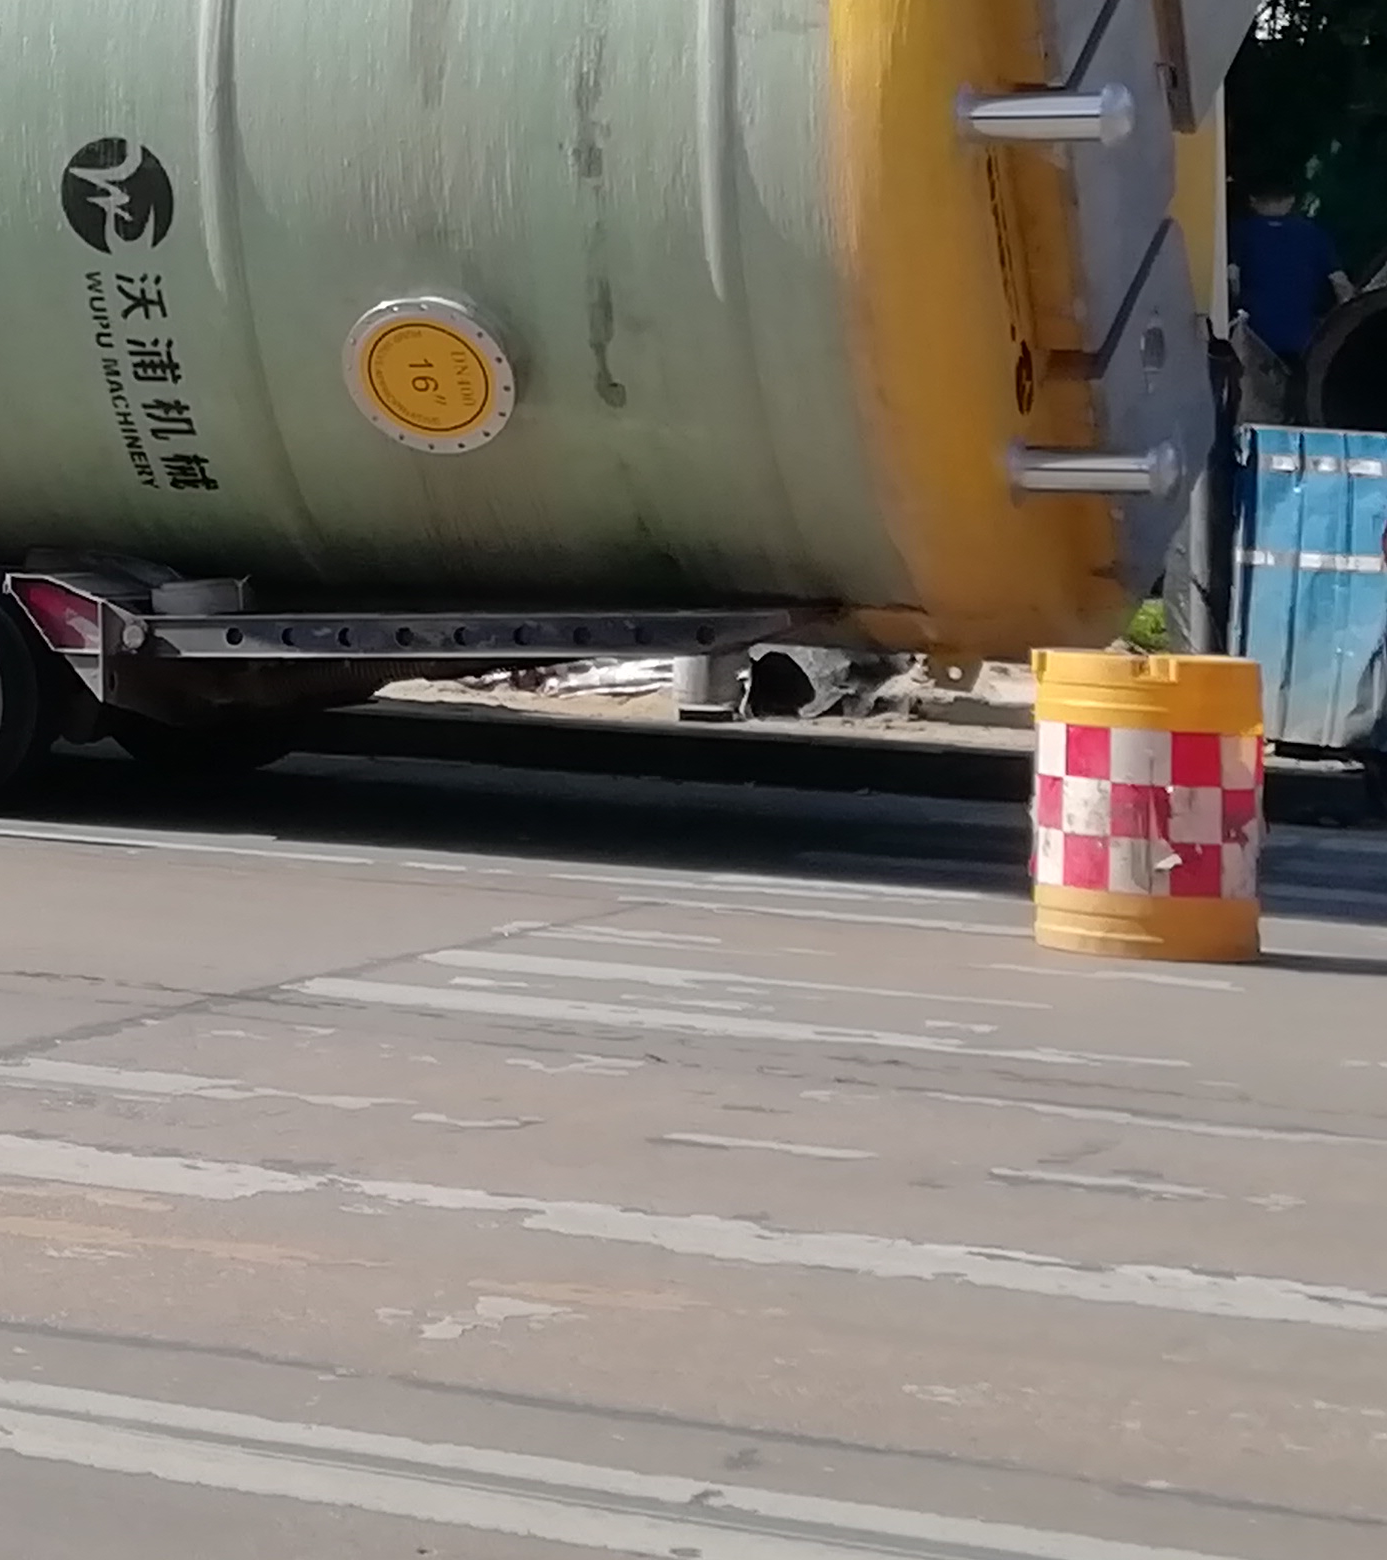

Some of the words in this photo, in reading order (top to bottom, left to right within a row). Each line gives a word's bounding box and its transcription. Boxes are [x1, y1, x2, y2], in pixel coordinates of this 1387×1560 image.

[84, 271, 114, 349] WUPU
[101, 355, 160, 489] MACHINERY
[114, 272, 219, 491] 沃浦机械
